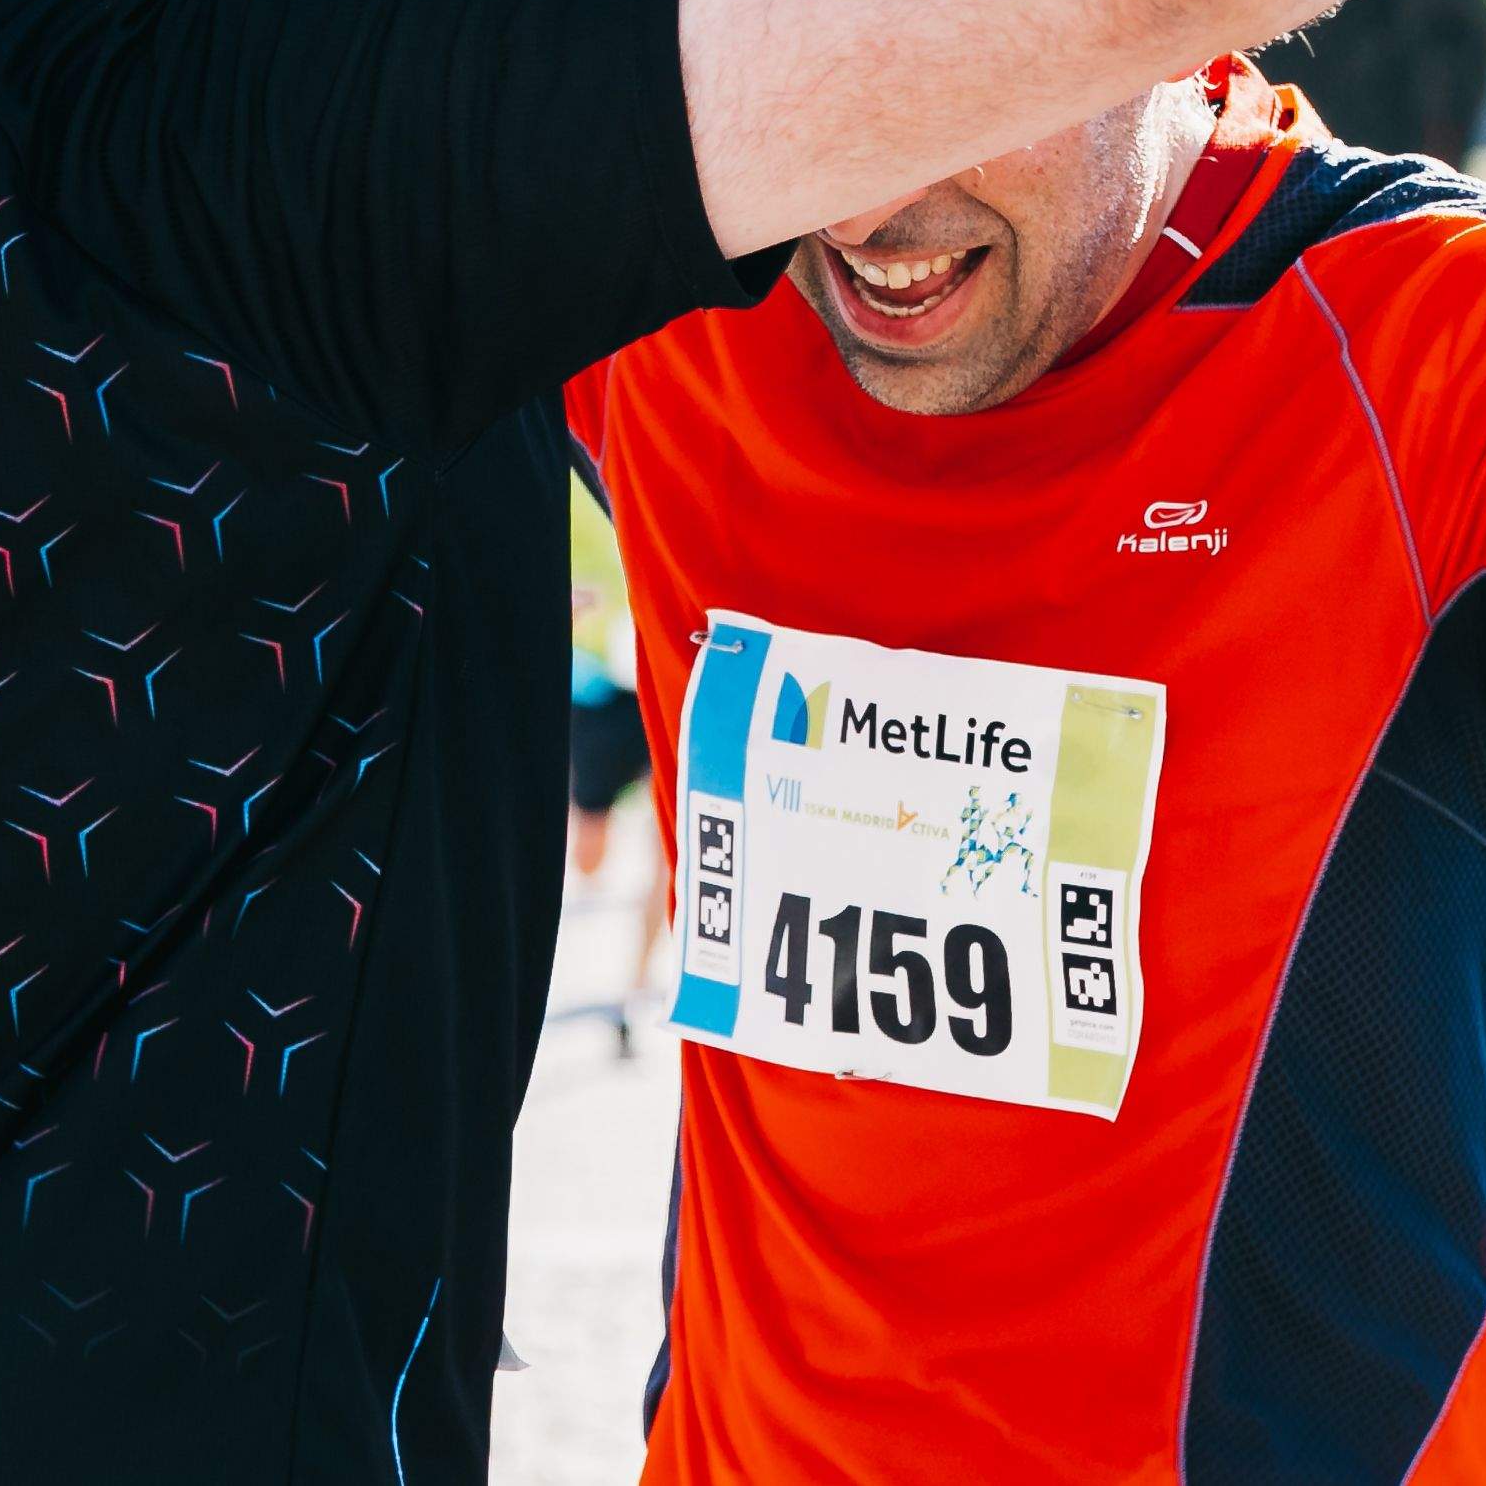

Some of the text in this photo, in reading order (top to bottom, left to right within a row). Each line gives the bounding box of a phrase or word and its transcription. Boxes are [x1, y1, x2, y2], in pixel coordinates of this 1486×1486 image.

[1117, 528, 1228, 555] Kalenji
[839, 697, 1032, 774] MetLife
[766, 773, 802, 814] VIII
[841, 810, 894, 830] MADRID
[764, 891, 1014, 1058] 4159
